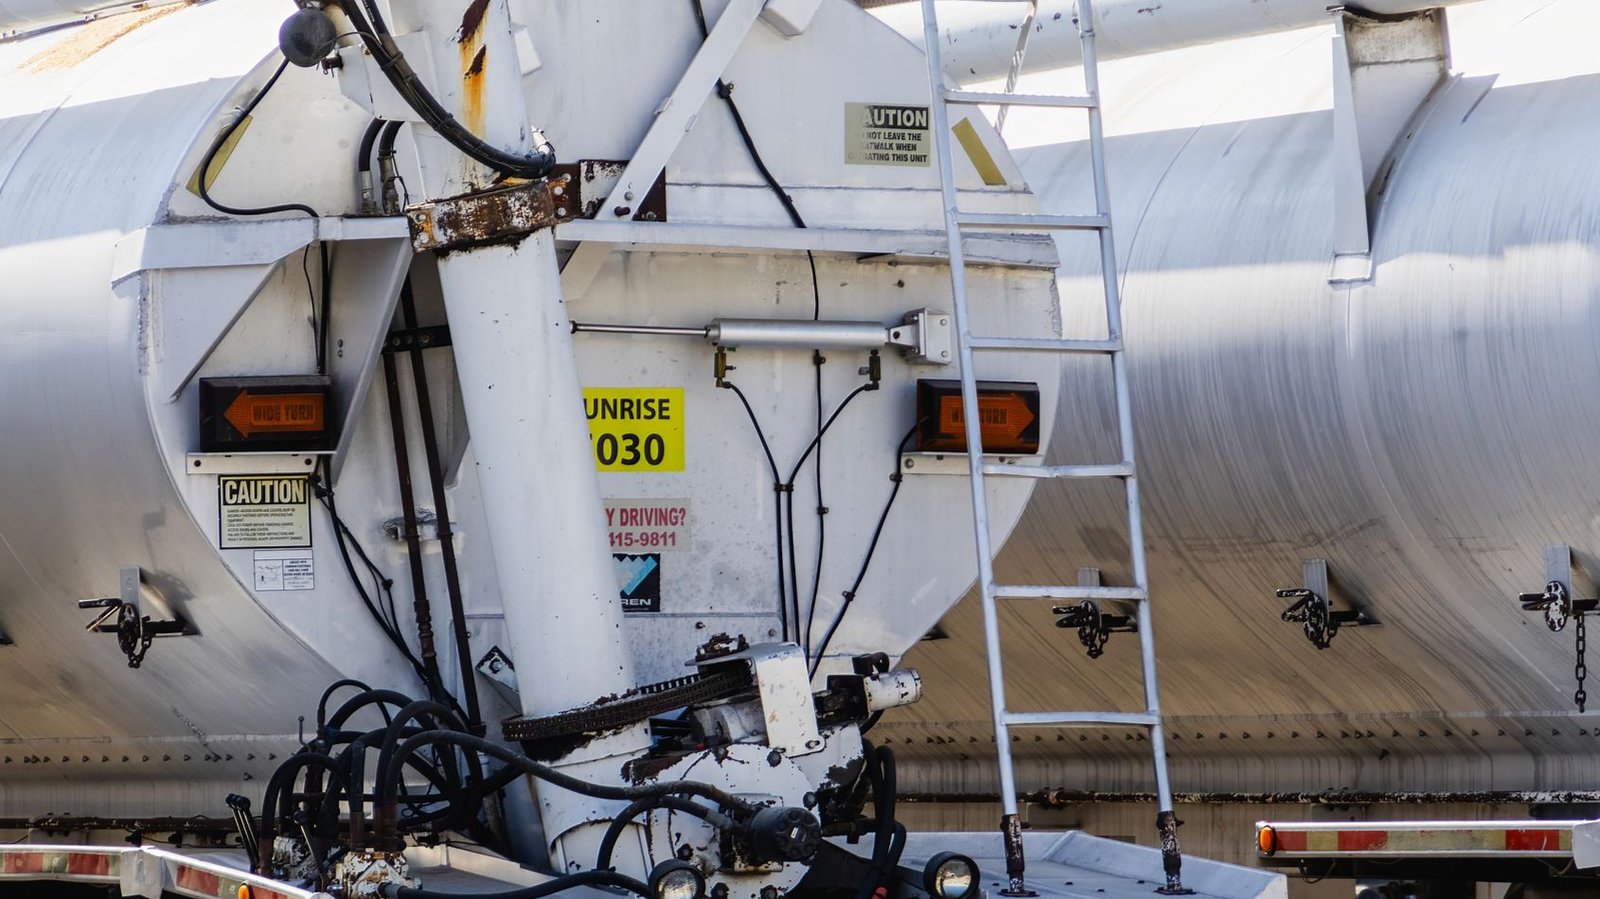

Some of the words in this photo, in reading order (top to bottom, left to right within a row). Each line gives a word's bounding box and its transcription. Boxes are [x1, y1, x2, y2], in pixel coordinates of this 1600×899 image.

[883, 132, 906, 140] LEAVE
[907, 132, 922, 141] THE
[863, 142, 894, 151] ATWALK
[895, 143, 917, 152] WHEN
[891, 153, 908, 162] THIS
[909, 153, 928, 163] UNIT
[253, 404, 281, 421] WIDE
[284, 403, 316, 421] TURN
[589, 433, 665, 466] 030
[224, 479, 305, 504] CAUTION
[619, 507, 687, 527] DRIVING?
